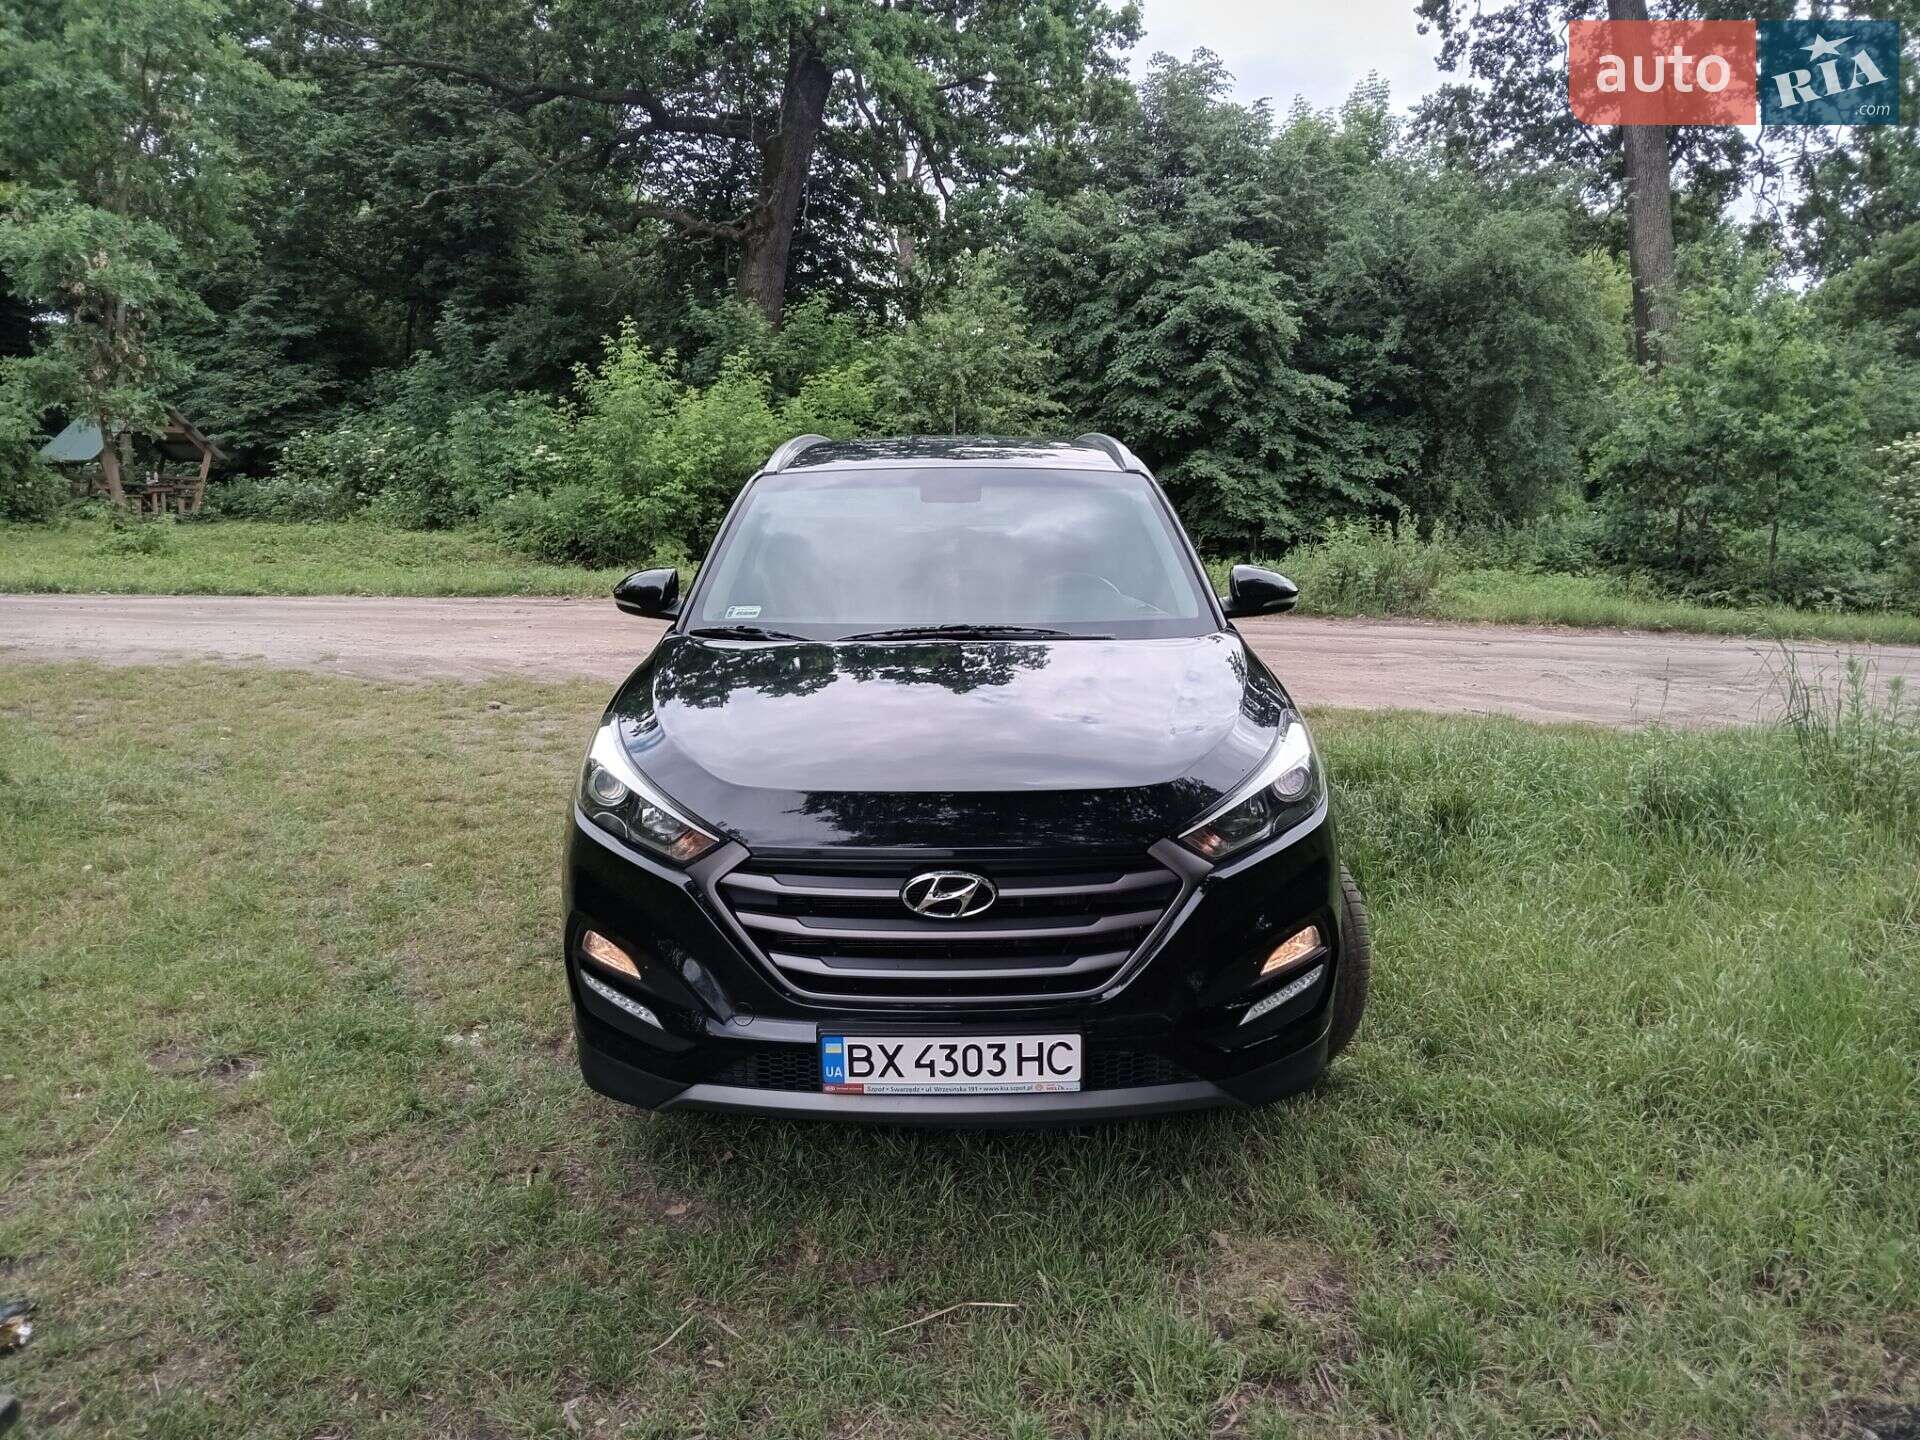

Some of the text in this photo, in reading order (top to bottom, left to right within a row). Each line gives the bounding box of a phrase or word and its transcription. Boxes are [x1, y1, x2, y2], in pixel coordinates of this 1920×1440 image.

[847, 1041, 1073, 1078] BX 4303 HC
[826, 1067, 843, 1078] UA
